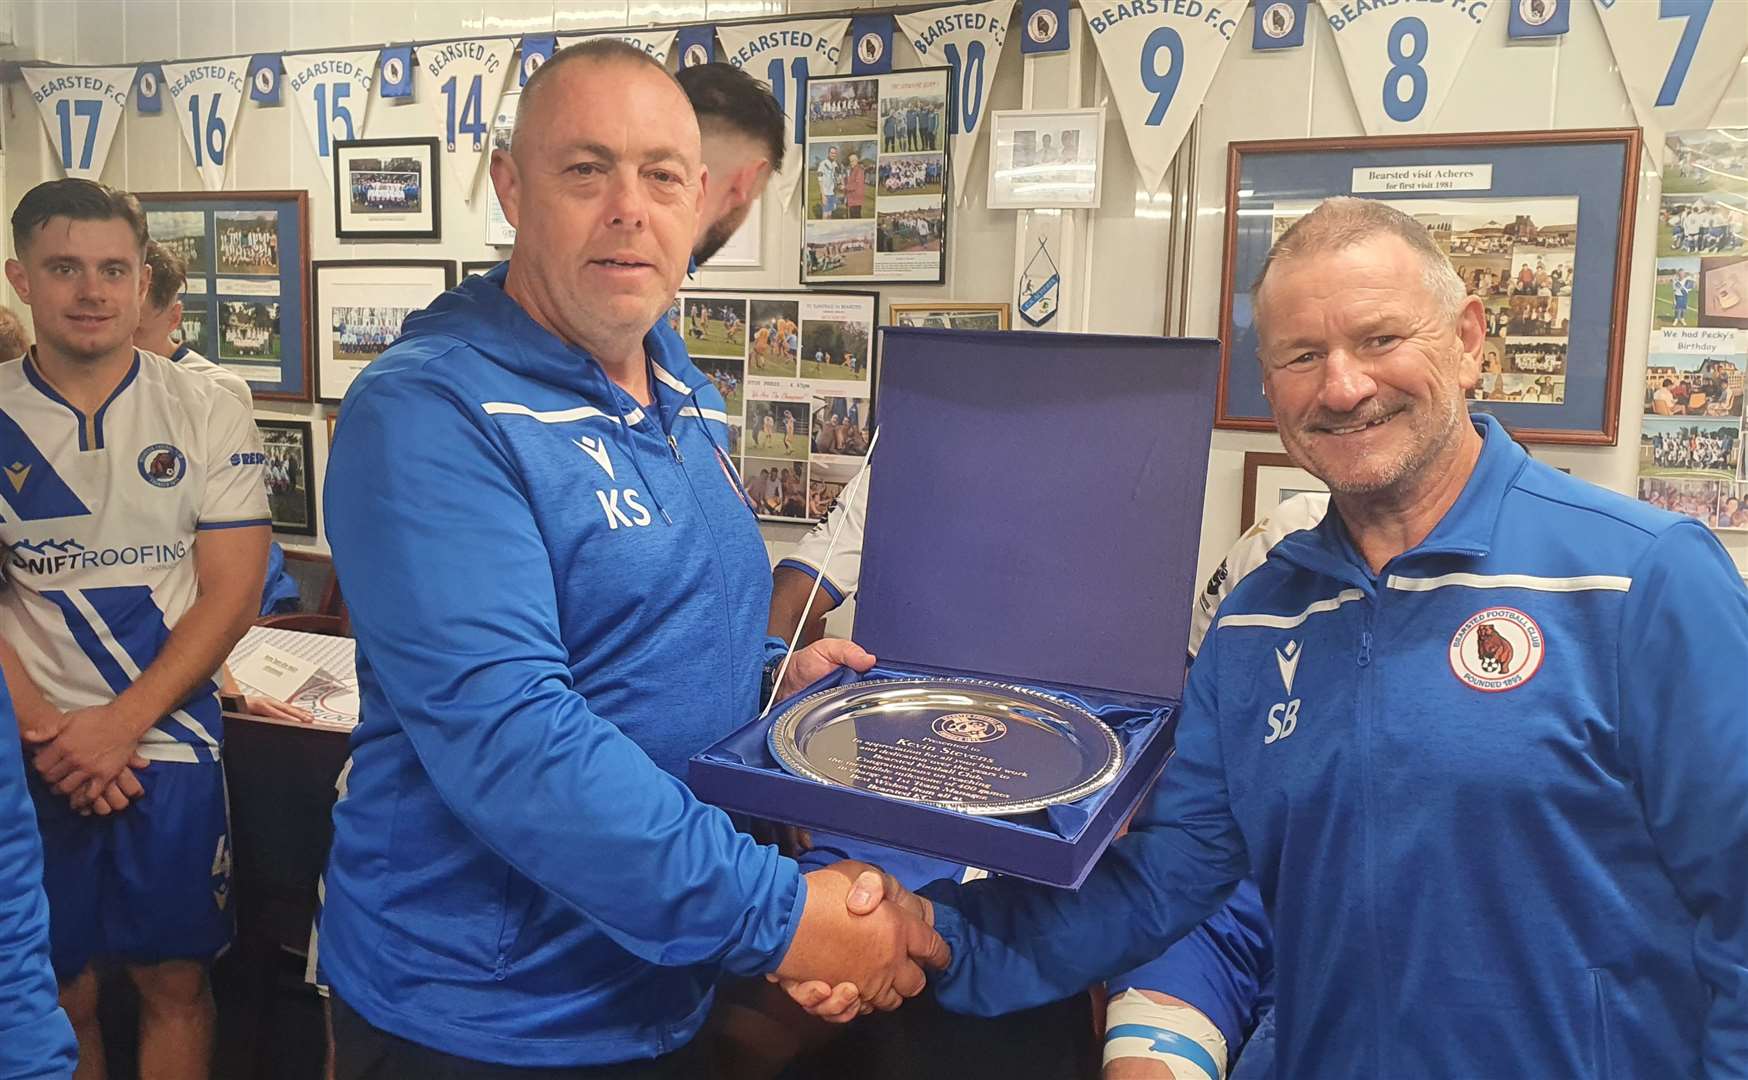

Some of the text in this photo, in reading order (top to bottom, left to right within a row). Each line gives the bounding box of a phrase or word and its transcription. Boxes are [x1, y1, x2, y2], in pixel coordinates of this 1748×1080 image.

[914, 13, 986, 54] BEARSTED
[1089, 0, 1203, 34] BEARSTED
[1204, 8, 1236, 40] F.C.
[429, 42, 500, 77] BEARSTED FC
[730, 31, 813, 69] BEARSTED
[815, 41, 839, 65] F.C.
[1382, 16, 1428, 122] 8
[1653, 0, 1712, 107] 7
[33, 76, 126, 108] BEARSTED F.C.
[171, 66, 242, 97] BEARSTED F.C.
[291, 61, 352, 91] BEARSTED
[944, 40, 985, 134] 10
[1140, 26, 1184, 126] 9
[441, 75, 486, 152] 14
[768, 56, 808, 144] 11
[56, 99, 102, 169] 17
[189, 93, 226, 167] 16
[314, 82, 355, 157] 15
[1369, 169, 1474, 181] Bearsted visit Acheres
[1663, 330, 1678, 338] We
[1681, 330, 1699, 338] had
[1677, 342, 1718, 352] Birthday
[596, 488, 651, 529] KS
[1453, 610, 1541, 648] BEARSTED FOOTBALL CLUB
[1463, 672, 1502, 688] FOUNDED
[1265, 699, 1300, 744] SB
[865, 741, 922, 755] appreciation
[953, 758, 977, 767] your
[979, 763, 1002, 772] hard
[1004, 768, 1029, 778] work
[873, 753, 914, 766] Bearsted
[879, 749, 928, 763] dedication
[930, 759, 952, 768] over
[953, 763, 969, 771] the
[971, 768, 997, 777] years
[896, 738, 993, 763] Kevin Stevens
[867, 783, 912, 797] Bearsted
[948, 776, 992, 789] reaching
